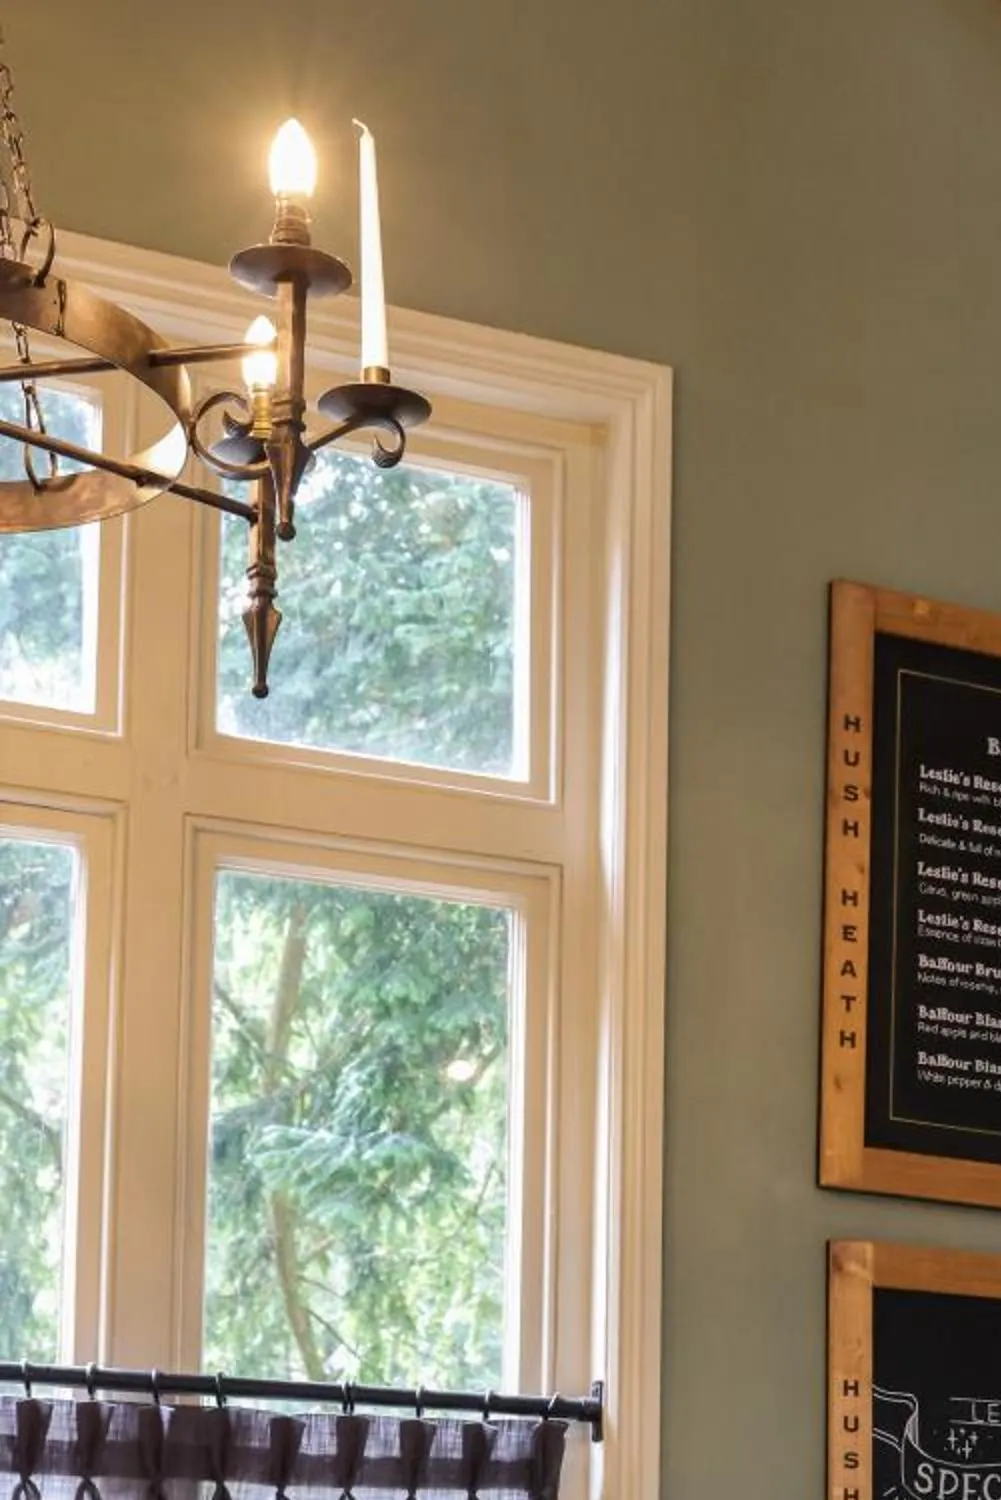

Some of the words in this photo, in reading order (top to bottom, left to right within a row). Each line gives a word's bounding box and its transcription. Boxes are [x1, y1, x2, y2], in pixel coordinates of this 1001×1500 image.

[842, 714, 861, 838] HUSH
[919, 764, 971, 787] Leslie's
[917, 807, 969, 831] Leslie's
[917, 861, 969, 884] Leslie's
[917, 908, 970, 931] Leslie's
[839, 889, 859, 1049] HEATH
[917, 953, 974, 974] Balfour
[918, 1004, 973, 1025] Balfour
[917, 1051, 972, 1071] Balfour
